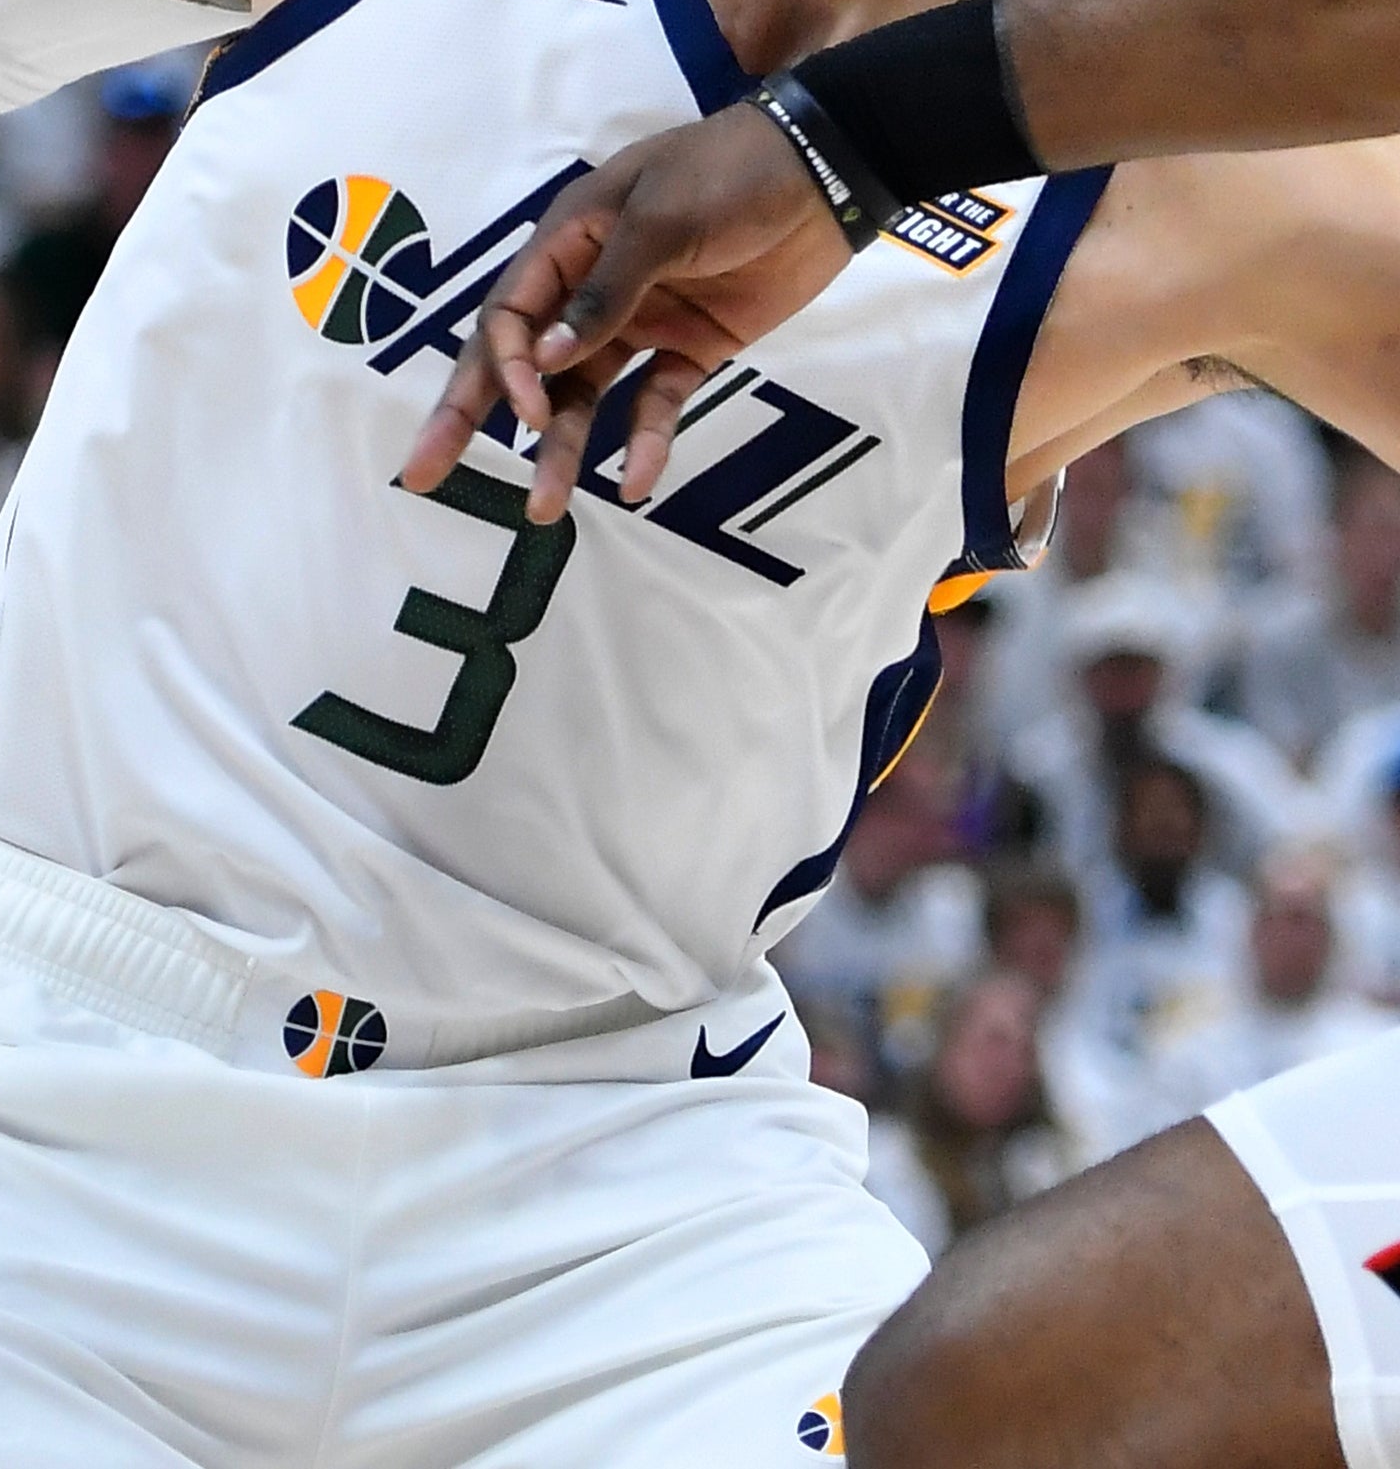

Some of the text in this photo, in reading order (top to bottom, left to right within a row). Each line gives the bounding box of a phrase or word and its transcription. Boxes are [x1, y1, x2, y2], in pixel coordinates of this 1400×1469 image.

[893, 207, 982, 262] IGHT
[955, 198, 995, 225] THE
[289, 461, 577, 785] 3
